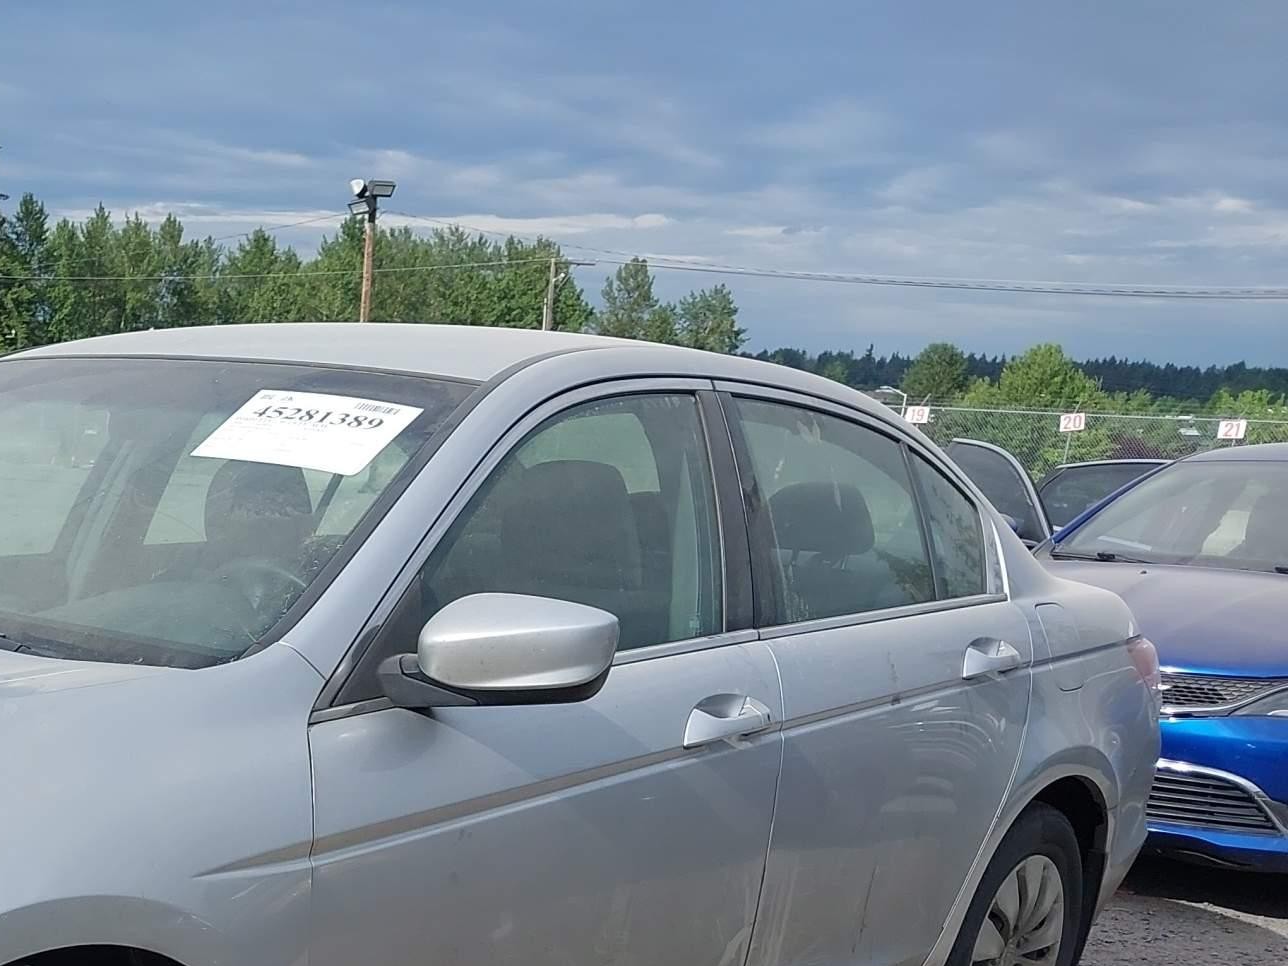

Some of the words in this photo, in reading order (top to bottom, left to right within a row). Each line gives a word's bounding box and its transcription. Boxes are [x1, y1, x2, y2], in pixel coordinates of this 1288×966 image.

[253, 405, 384, 429] 45281389
[912, 408, 924, 421] 19
[1063, 415, 1083, 430] 20
[1223, 422, 1241, 437] 21
